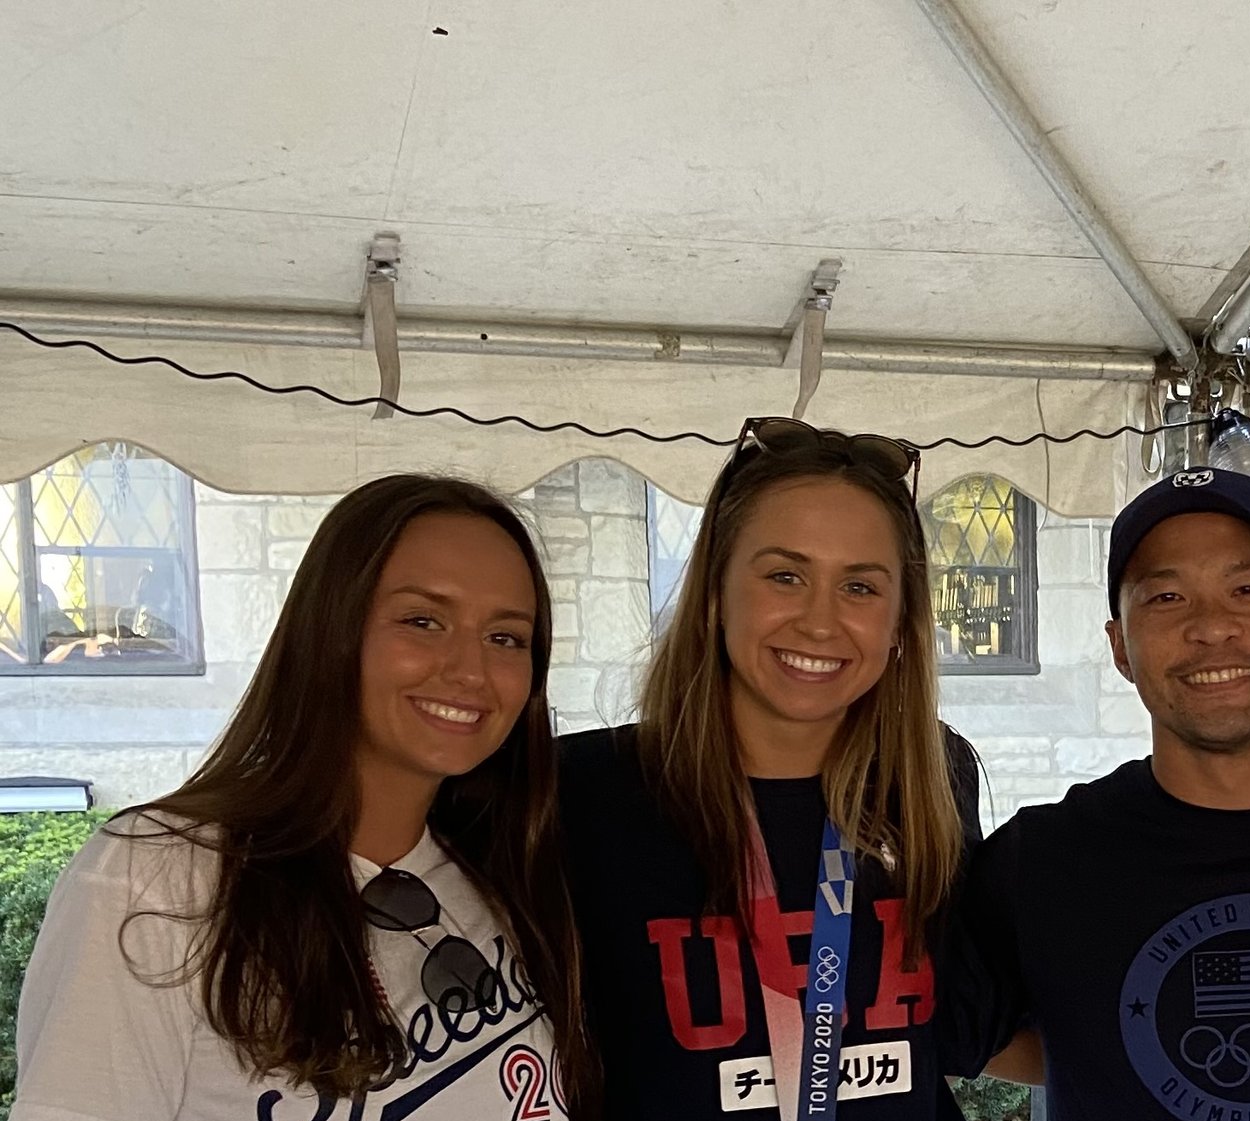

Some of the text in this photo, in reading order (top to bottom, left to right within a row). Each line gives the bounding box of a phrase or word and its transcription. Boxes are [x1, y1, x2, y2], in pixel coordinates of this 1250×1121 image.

[1148, 902, 1237, 964] UNITED
[734, 1054, 899, 1100] チーメリカ
[809, 1003, 833, 1115] TOKYO 2020
